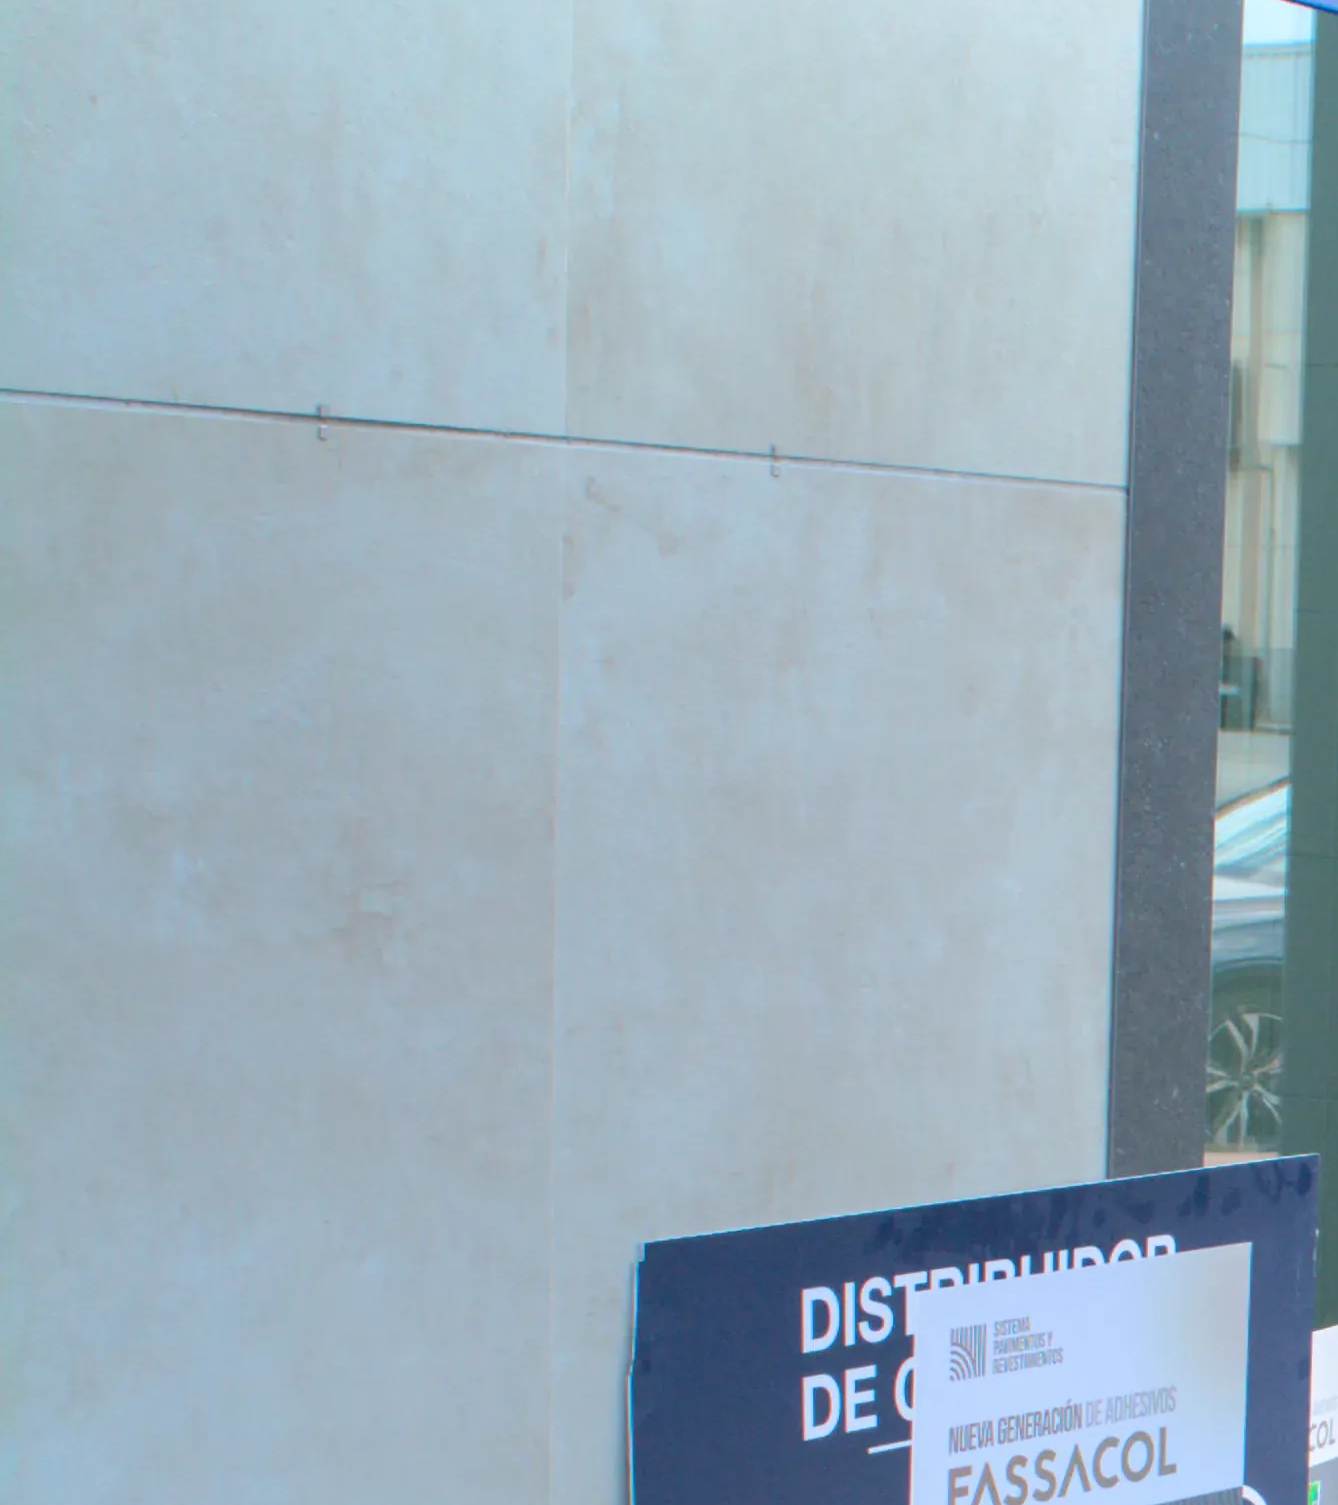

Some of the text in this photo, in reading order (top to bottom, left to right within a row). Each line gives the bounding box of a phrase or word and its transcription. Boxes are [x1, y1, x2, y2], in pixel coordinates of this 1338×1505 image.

[993, 1316, 1030, 1337] SISTEMA
[993, 1331, 1054, 1355] PAVIMENTOS Y
[992, 1347, 1063, 1374] REVESTIMIENTOS
[801, 1364, 880, 1442] DE
[948, 1386, 1178, 1456] NUEVA GENERACIÓN DE ADHESIVOS
